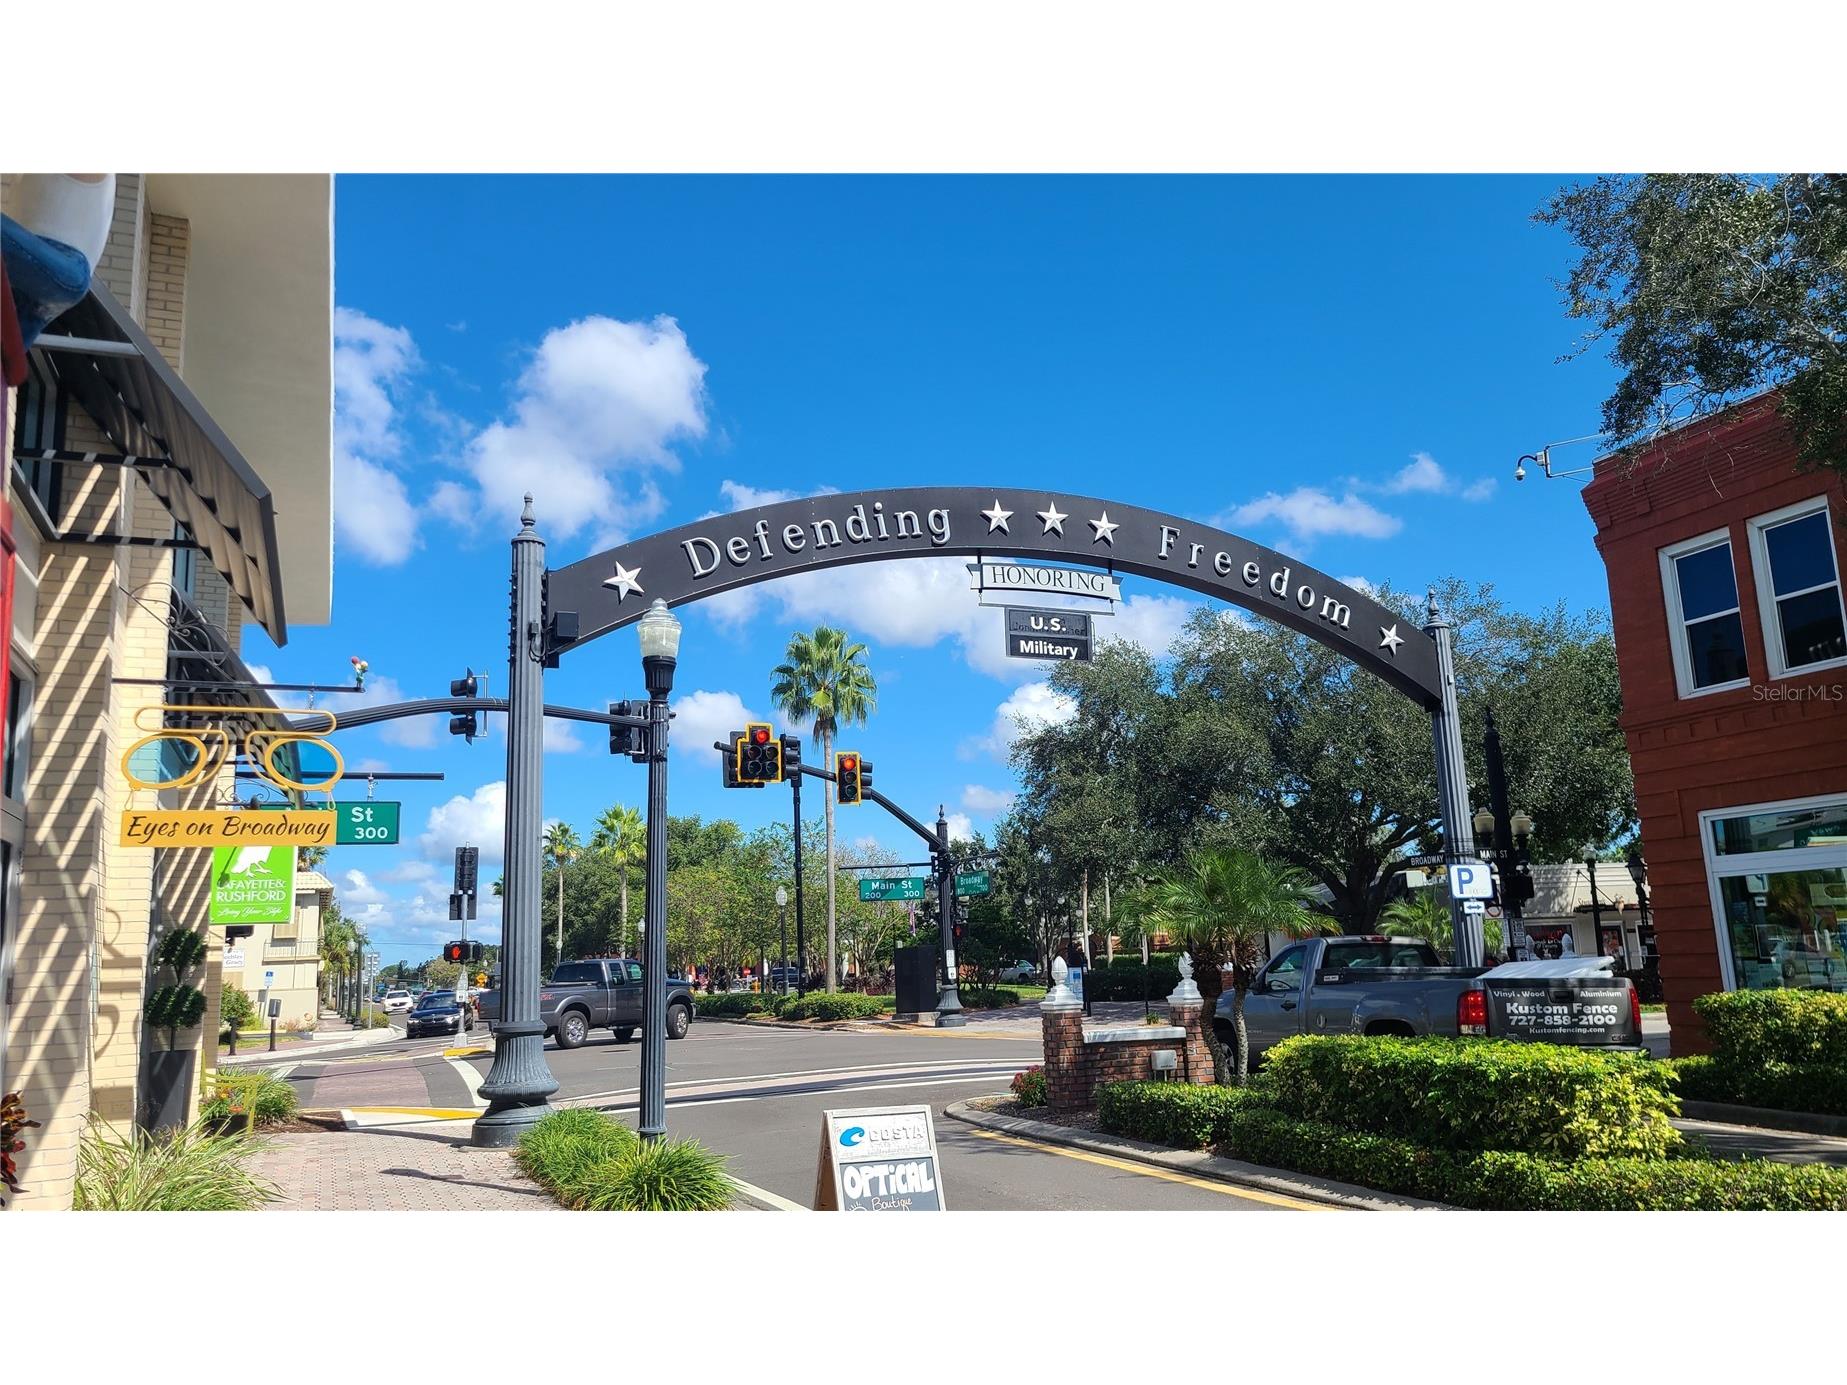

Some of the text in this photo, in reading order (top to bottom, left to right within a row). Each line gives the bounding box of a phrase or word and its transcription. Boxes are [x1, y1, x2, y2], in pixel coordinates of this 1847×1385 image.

[682, 502, 1352, 631] Defending Freedom
[991, 565, 1106, 593] HONORING
[1030, 616, 1067, 632] U.S.
[1019, 639, 1079, 661] Military
[351, 806, 373, 823] St
[127, 814, 331, 844] Eyes on Broadway
[354, 826, 389, 840] 300
[1410, 854, 1444, 866] BROADWAY
[1479, 849, 1508, 859] MAIN ST
[871, 880, 913, 890] Main St
[960, 875, 983, 886] Broadway
[1456, 867, 1474, 895] P
[216, 890, 287, 903] RUSHFORD
[865, 890, 920, 900] 200 300
[1493, 990, 1515, 999] Vinyl
[1521, 990, 1545, 998] Wood
[1506, 1002, 1618, 1014] Kustom Fence
[1509, 1015, 1617, 1026] 727-858-2100
[1529, 1026, 1606, 1034] Kustomfencing.com
[868, 1124, 925, 1142] COSTA
[871, 1194, 913, 1211] Boutique
